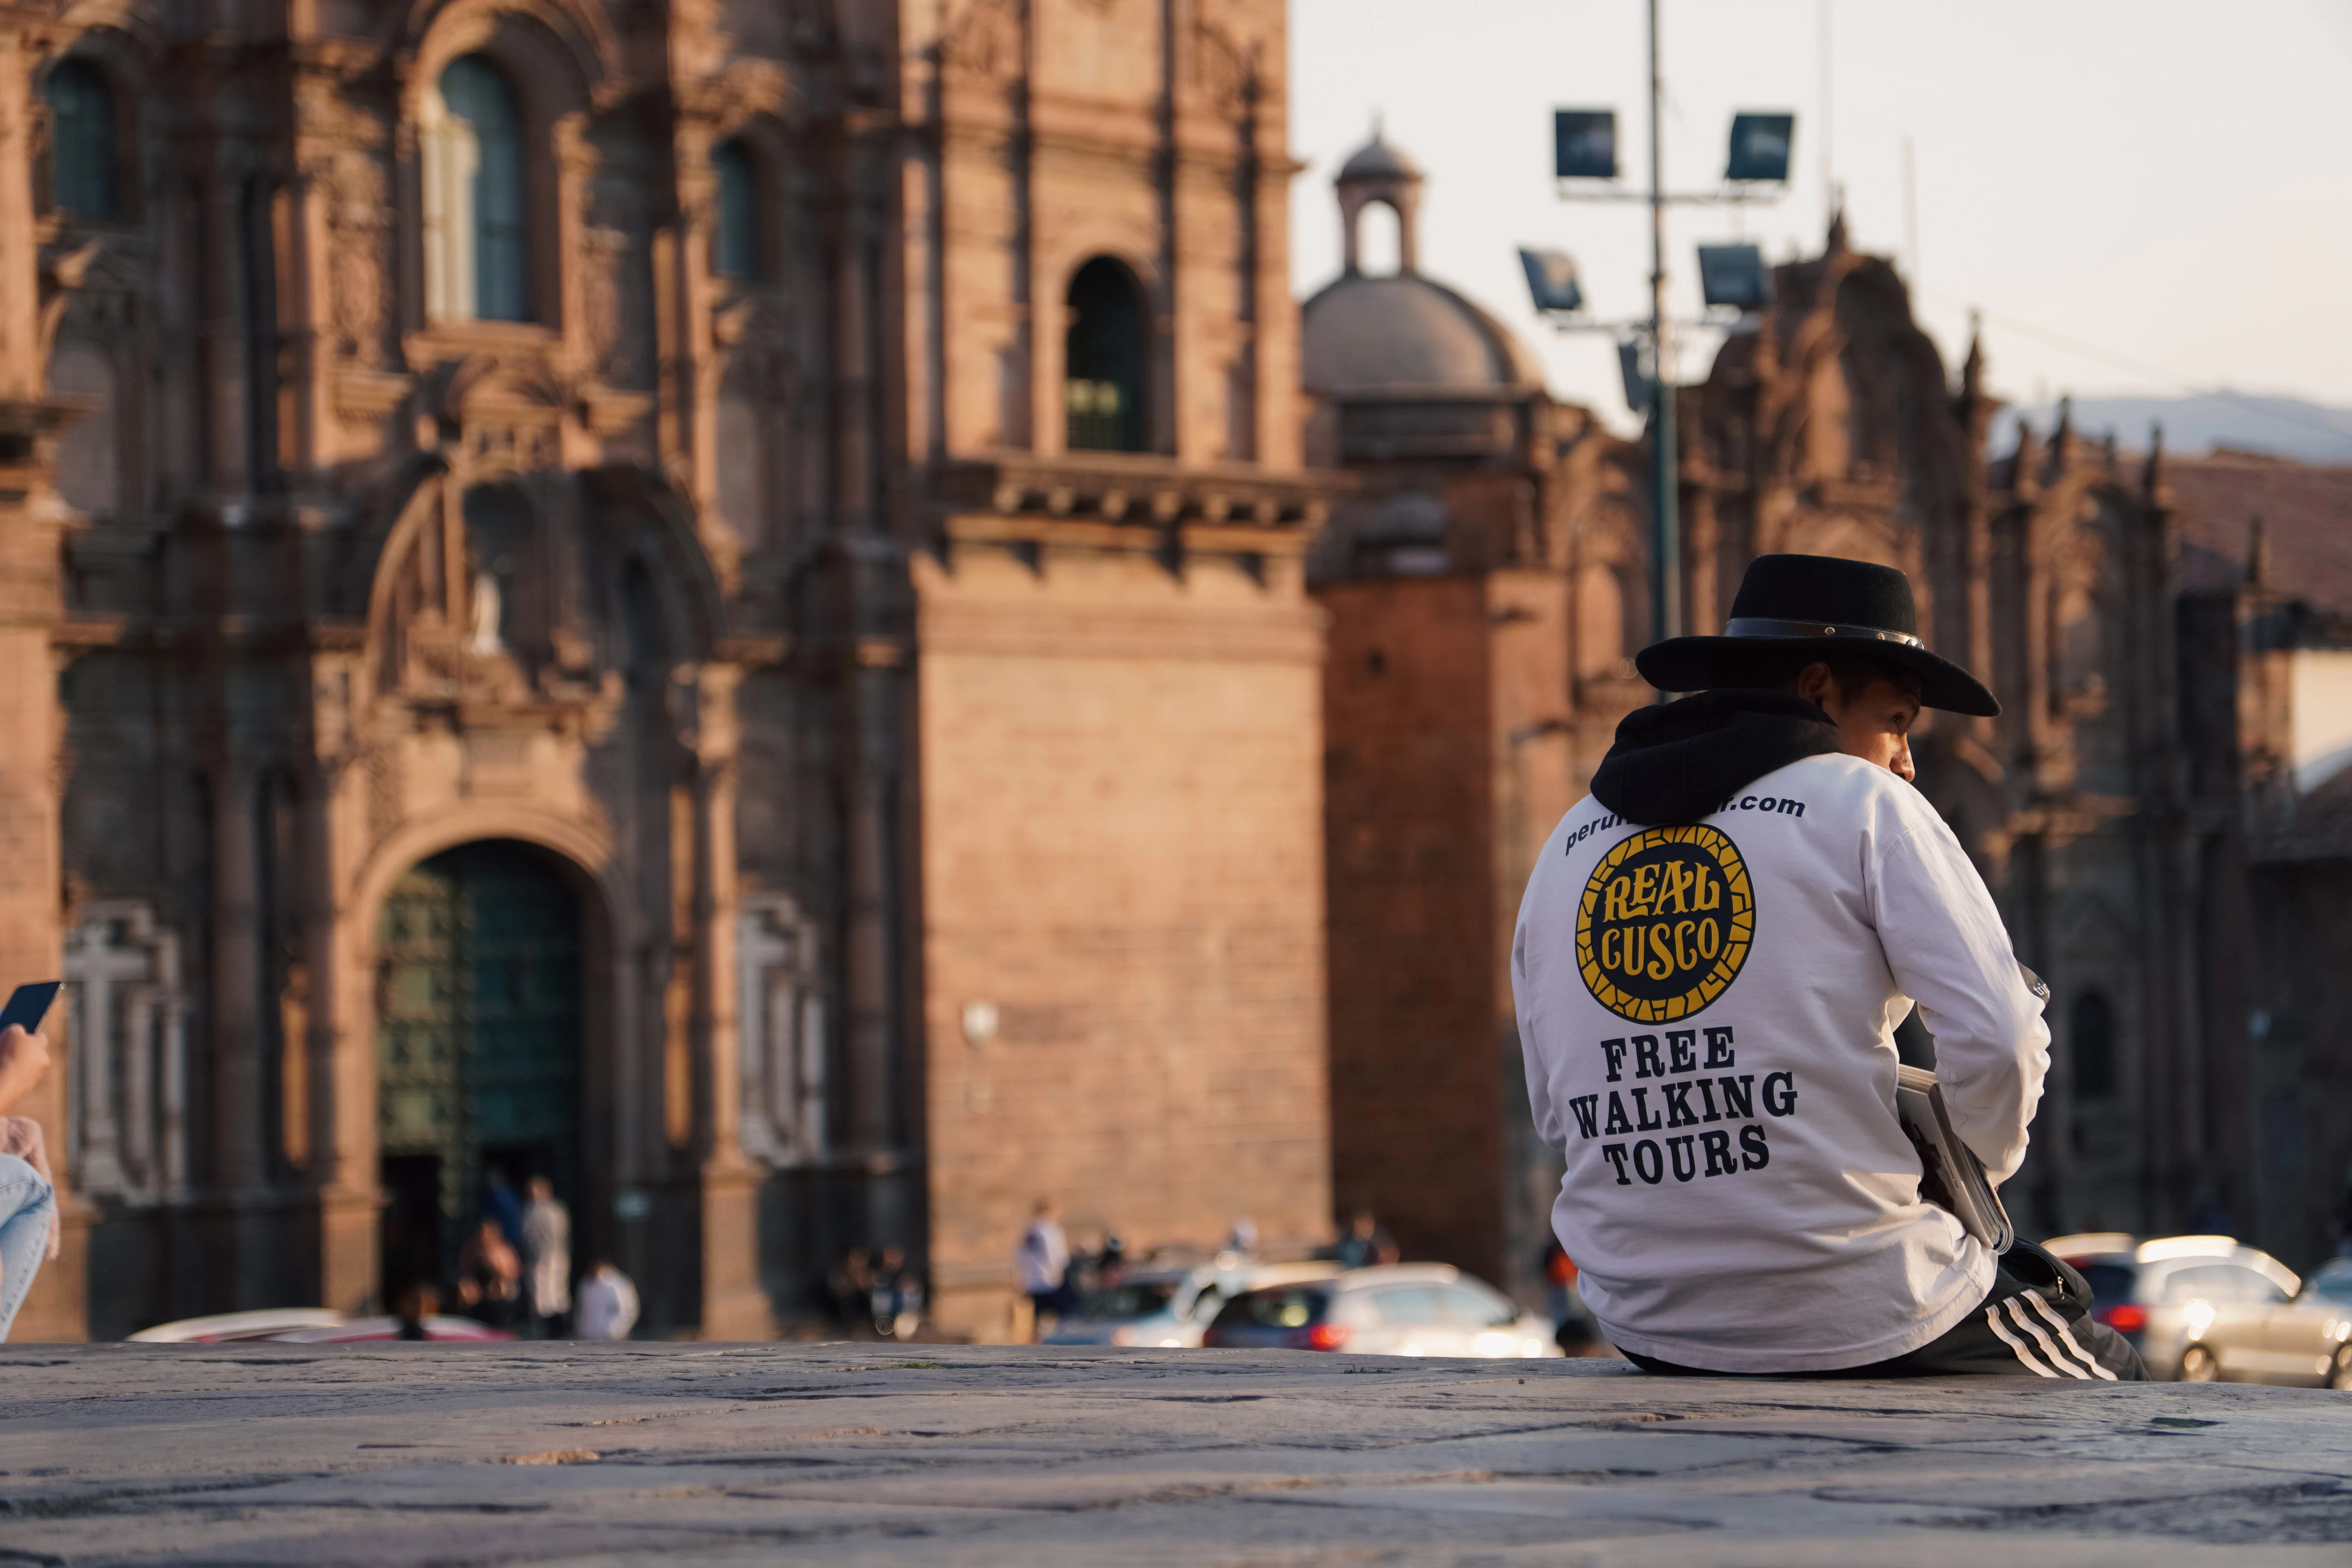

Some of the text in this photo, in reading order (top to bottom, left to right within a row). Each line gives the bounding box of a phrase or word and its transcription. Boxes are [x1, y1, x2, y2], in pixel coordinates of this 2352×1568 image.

[1603, 860, 1720, 922] REAL
[1602, 918, 1719, 980] CUSCO
[1600, 1026, 1735, 1083] FREE
[1569, 1072, 1798, 1139] WALKING
[1602, 1125, 1769, 1185] TOURS
